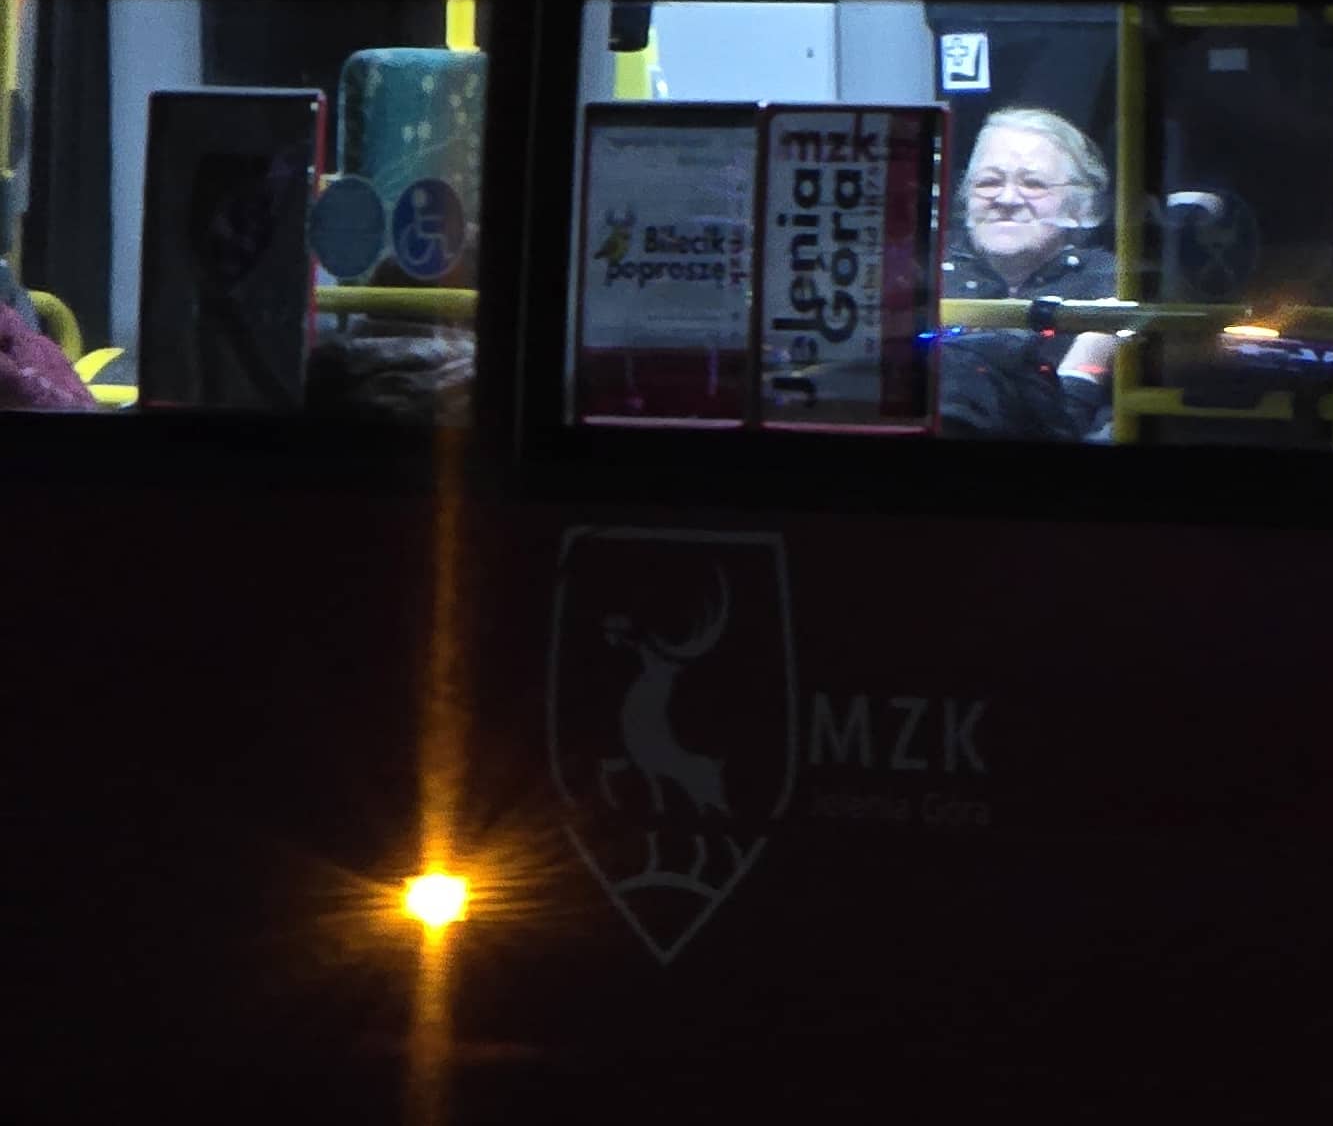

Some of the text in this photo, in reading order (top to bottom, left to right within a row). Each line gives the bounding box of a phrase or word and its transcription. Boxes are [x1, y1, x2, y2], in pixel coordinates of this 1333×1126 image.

[781, 113, 879, 162] mzk
[643, 224, 726, 256] Bilecik
[814, 168, 863, 344] Góra
[605, 259, 728, 289] poproszę
[772, 168, 821, 408] Jelenia
[807, 690, 990, 774] MZK
